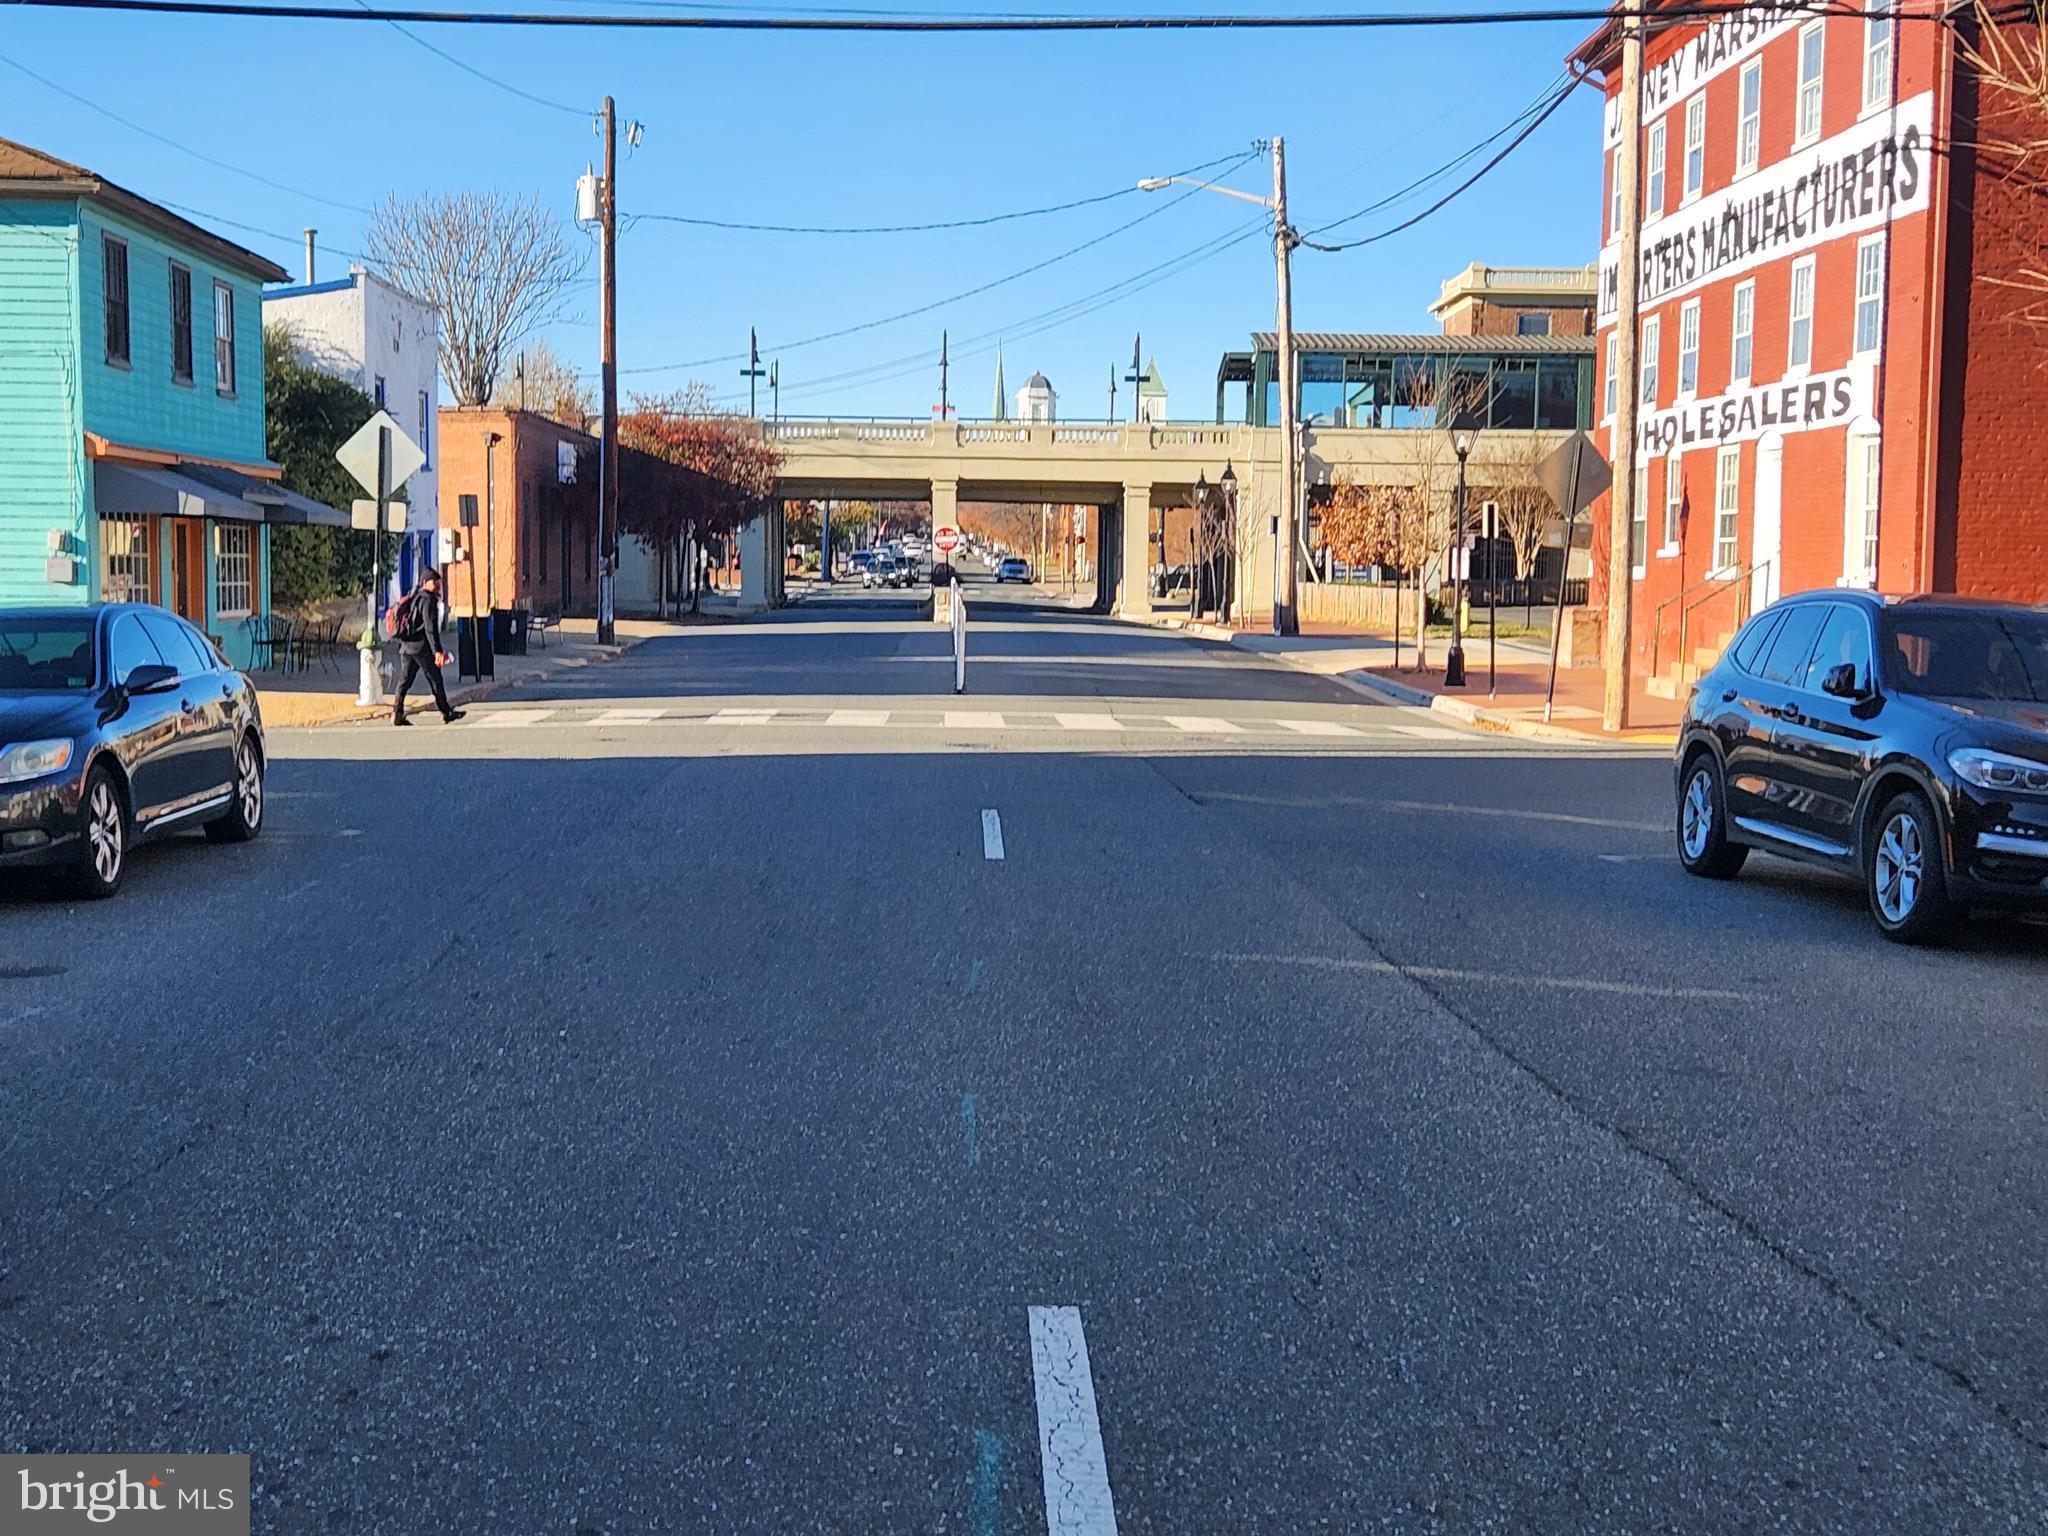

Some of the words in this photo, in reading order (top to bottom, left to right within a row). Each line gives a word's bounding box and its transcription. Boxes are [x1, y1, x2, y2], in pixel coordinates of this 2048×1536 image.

[1610, 46, 1685, 139] JNEY
[1602, 226, 1696, 317] IMRTERS
[1703, 124, 1919, 275] MANUFACTURERS
[1637, 376, 1852, 452] HOLESALERS
